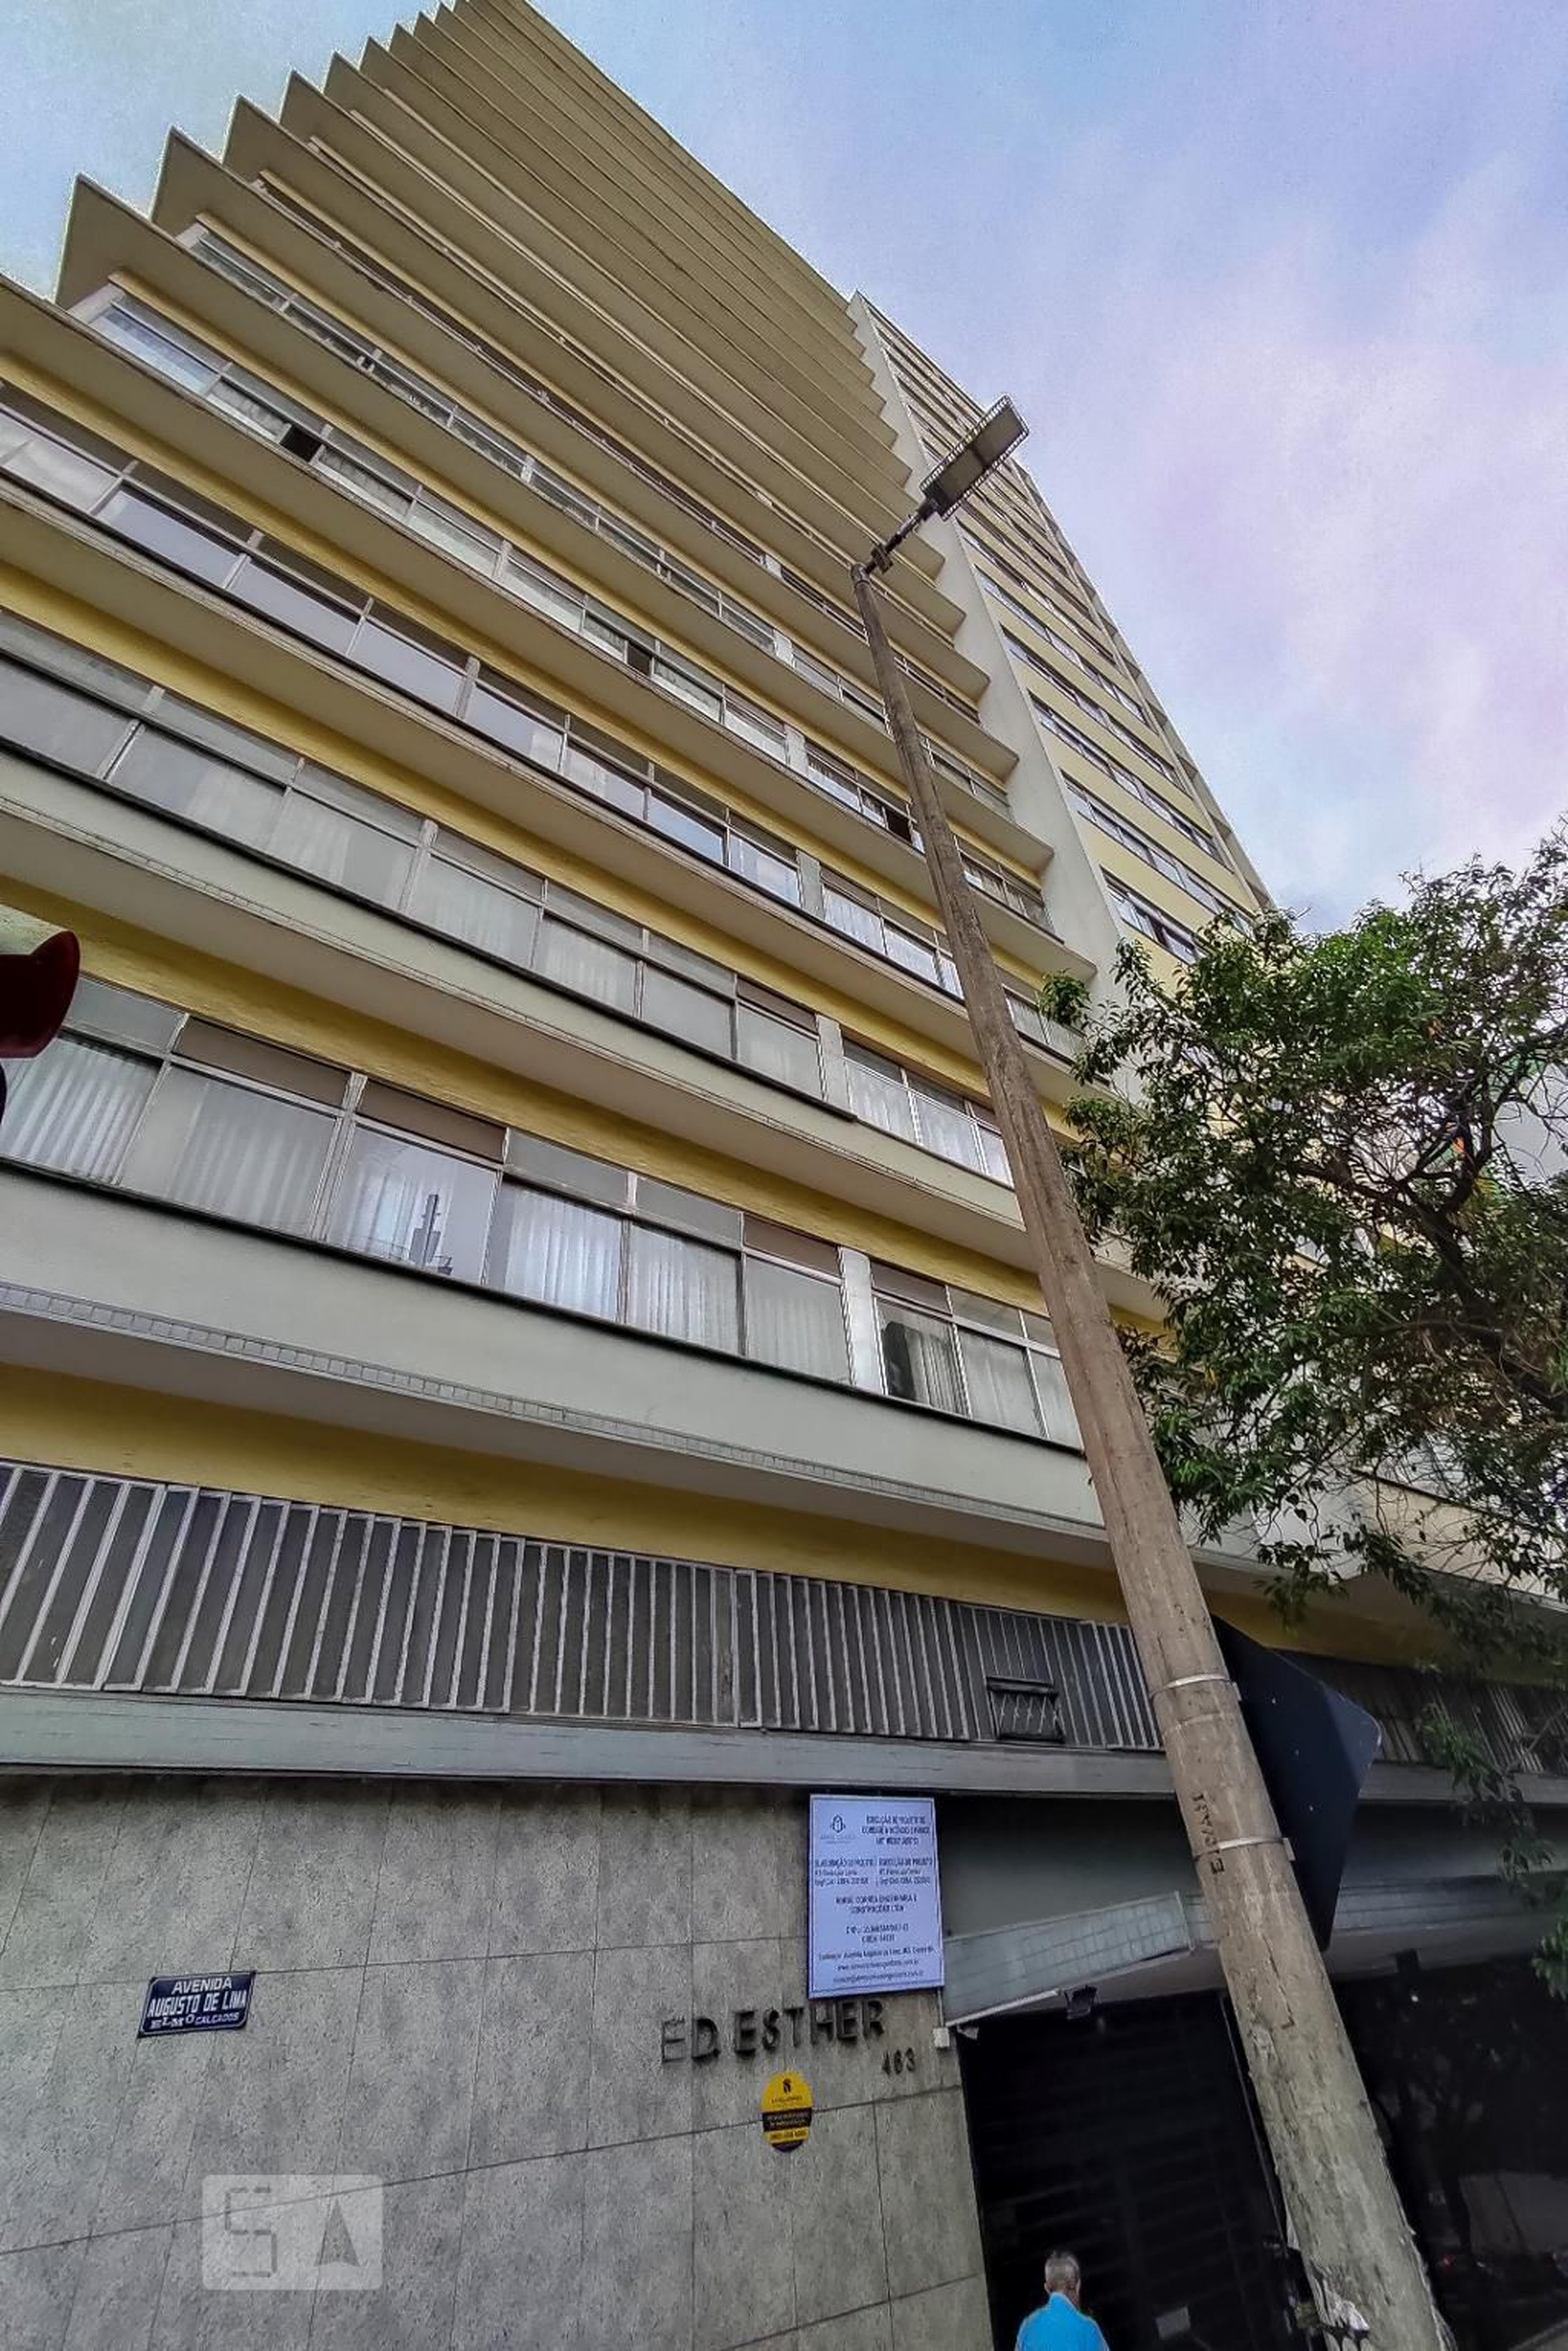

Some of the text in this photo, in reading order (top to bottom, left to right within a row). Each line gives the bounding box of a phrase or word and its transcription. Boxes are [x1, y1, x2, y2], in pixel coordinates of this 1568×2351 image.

[172, 1977, 232, 1994] AVENIDA
[147, 1990, 247, 2018] AUGUSTO DE LIMA
[735, 1999, 884, 2058] ESTHER
